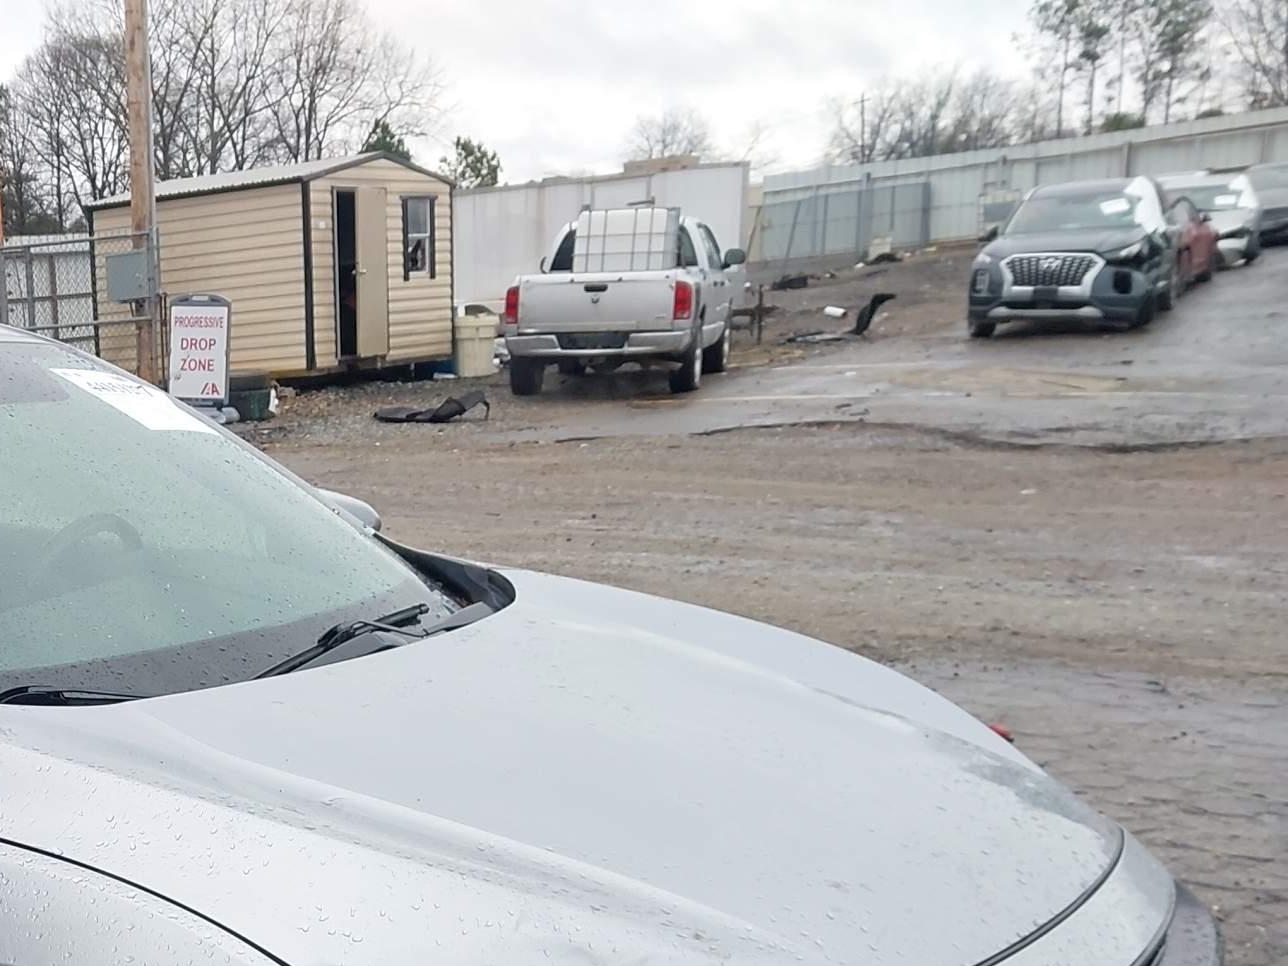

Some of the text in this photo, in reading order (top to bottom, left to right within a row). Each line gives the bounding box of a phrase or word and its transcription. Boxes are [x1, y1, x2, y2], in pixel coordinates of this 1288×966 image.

[174, 315, 224, 329] PROGRESSIVE
[180, 337, 217, 351] DROP
[180, 358, 215, 372] ZONE
